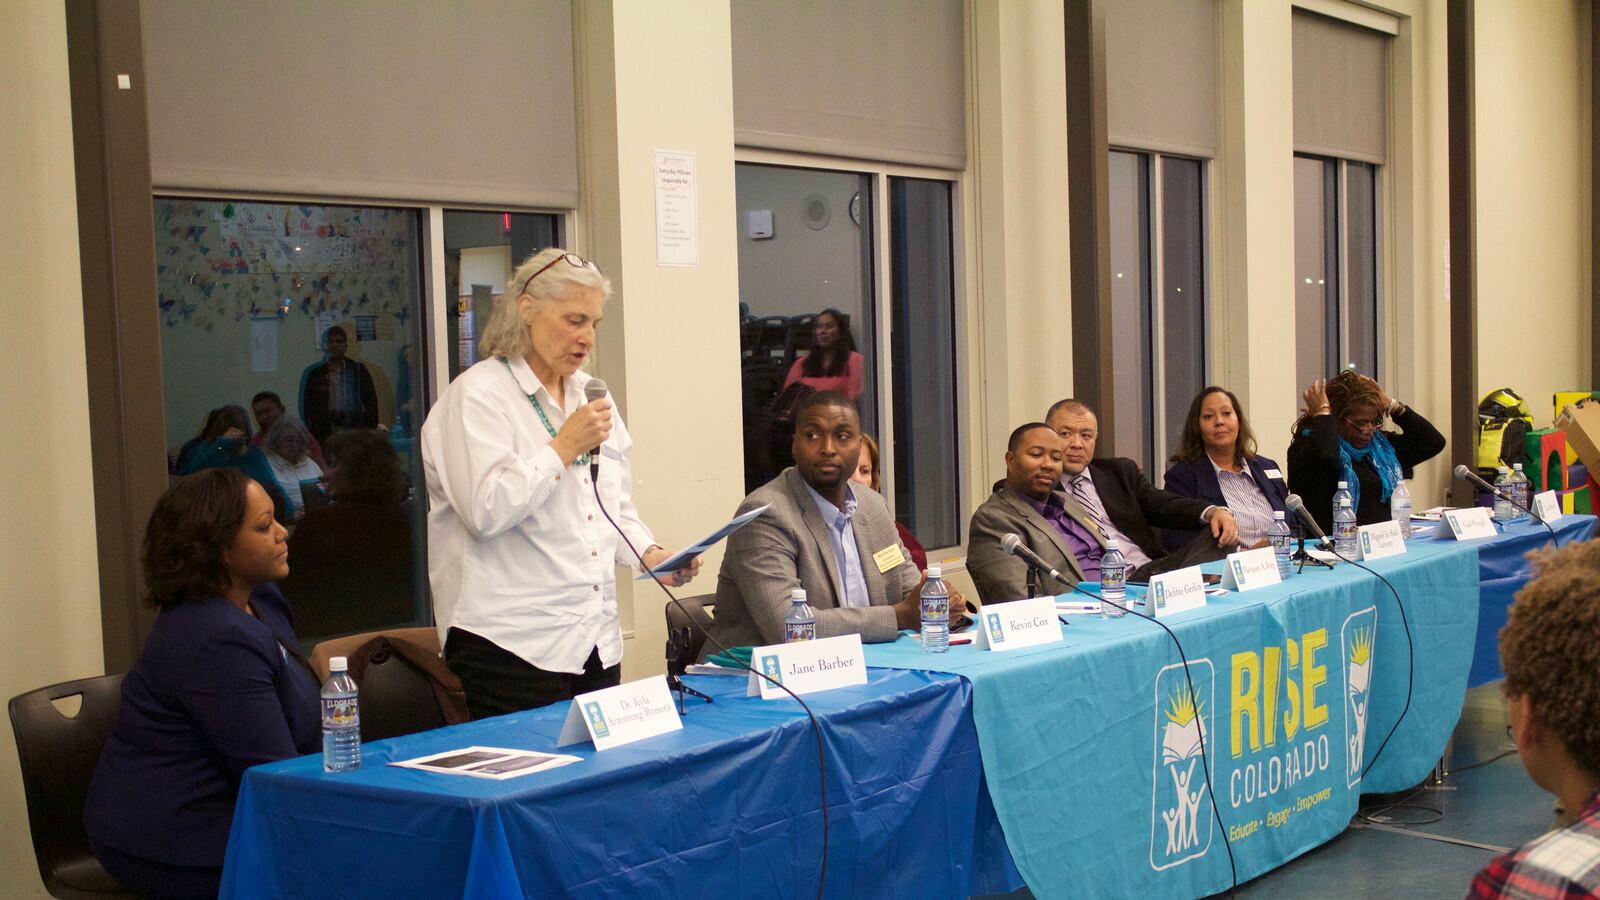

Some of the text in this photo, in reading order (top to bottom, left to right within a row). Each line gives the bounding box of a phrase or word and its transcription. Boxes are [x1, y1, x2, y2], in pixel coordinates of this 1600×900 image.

[1165, 582, 1202, 599] Debbie Gerkin
[1010, 616, 1049, 631] Kevin Cox
[789, 656, 854, 676] Jane Barber
[326, 699, 357, 708] ELDORADO
[620, 695, 650, 711] Dr. Kyla
[1231, 627, 1329, 760] RISE
[608, 704, 672, 727] Armstrong-Romero
[1230, 734, 1329, 809] COLORADO
[1229, 820, 1258, 842] Educate
[1296, 787, 1332, 813] Empower
